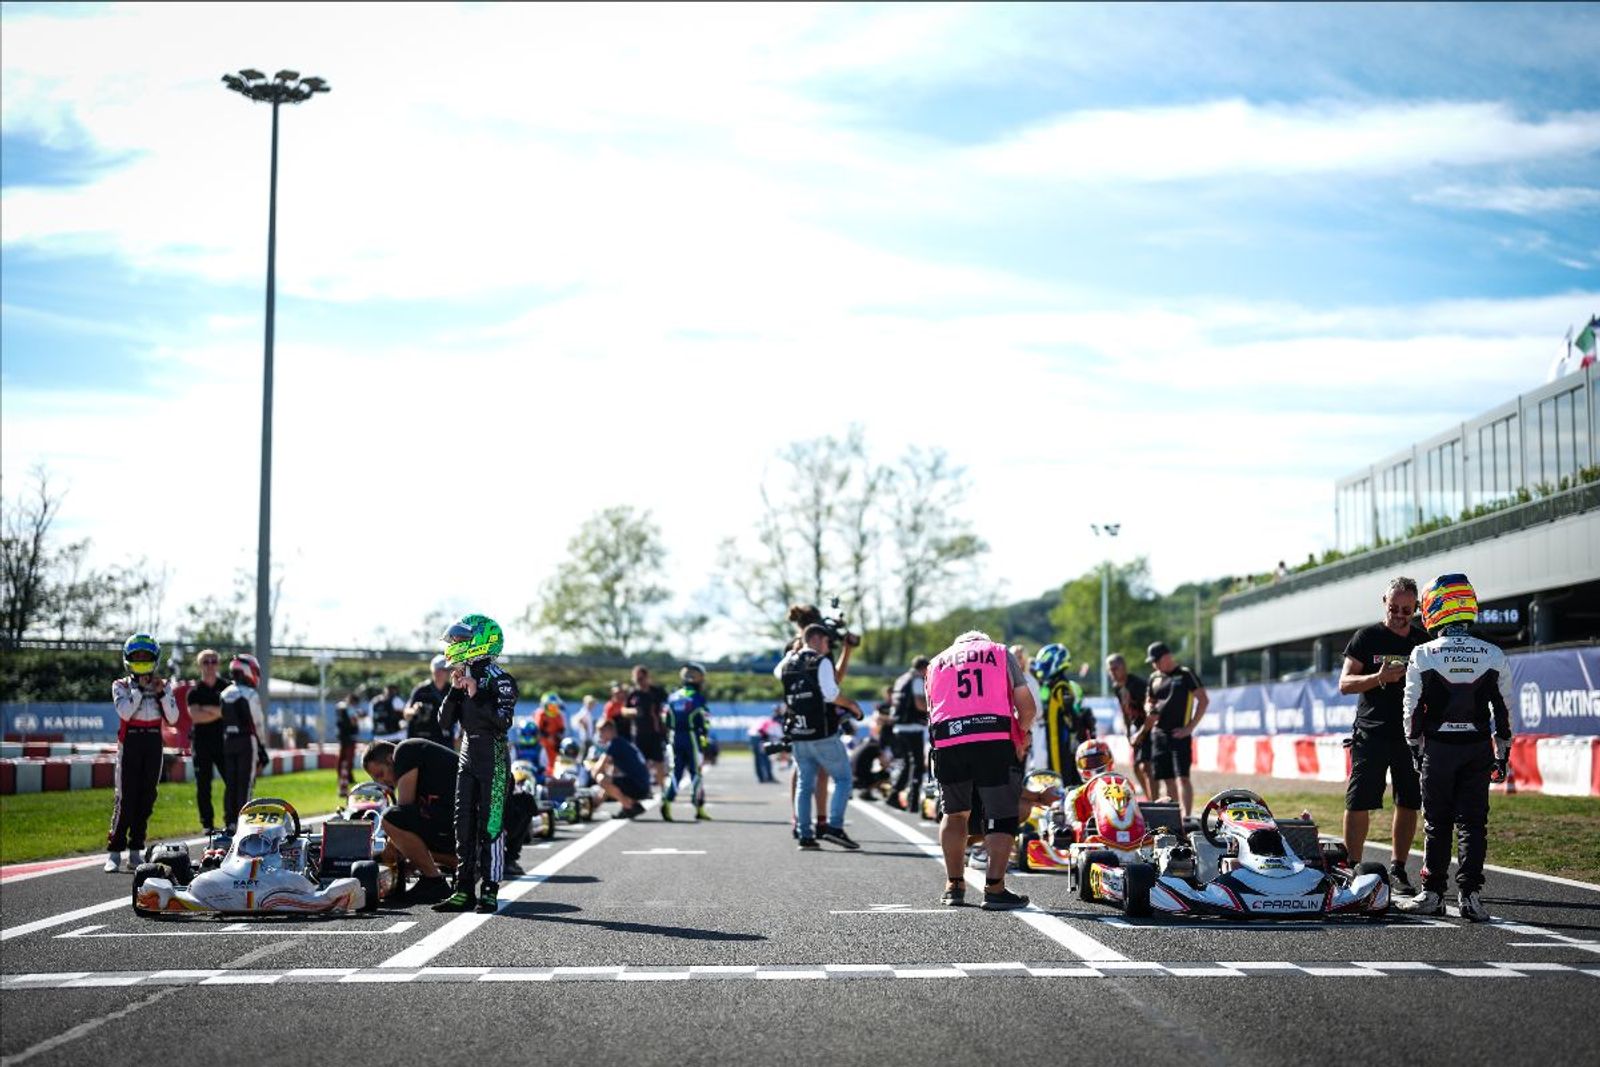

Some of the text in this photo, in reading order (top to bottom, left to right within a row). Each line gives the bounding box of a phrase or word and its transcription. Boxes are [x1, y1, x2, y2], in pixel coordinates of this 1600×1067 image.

[938, 649, 998, 670] MEDIA
[957, 668, 984, 699] 51
[43, 716, 104, 730] KARTING
